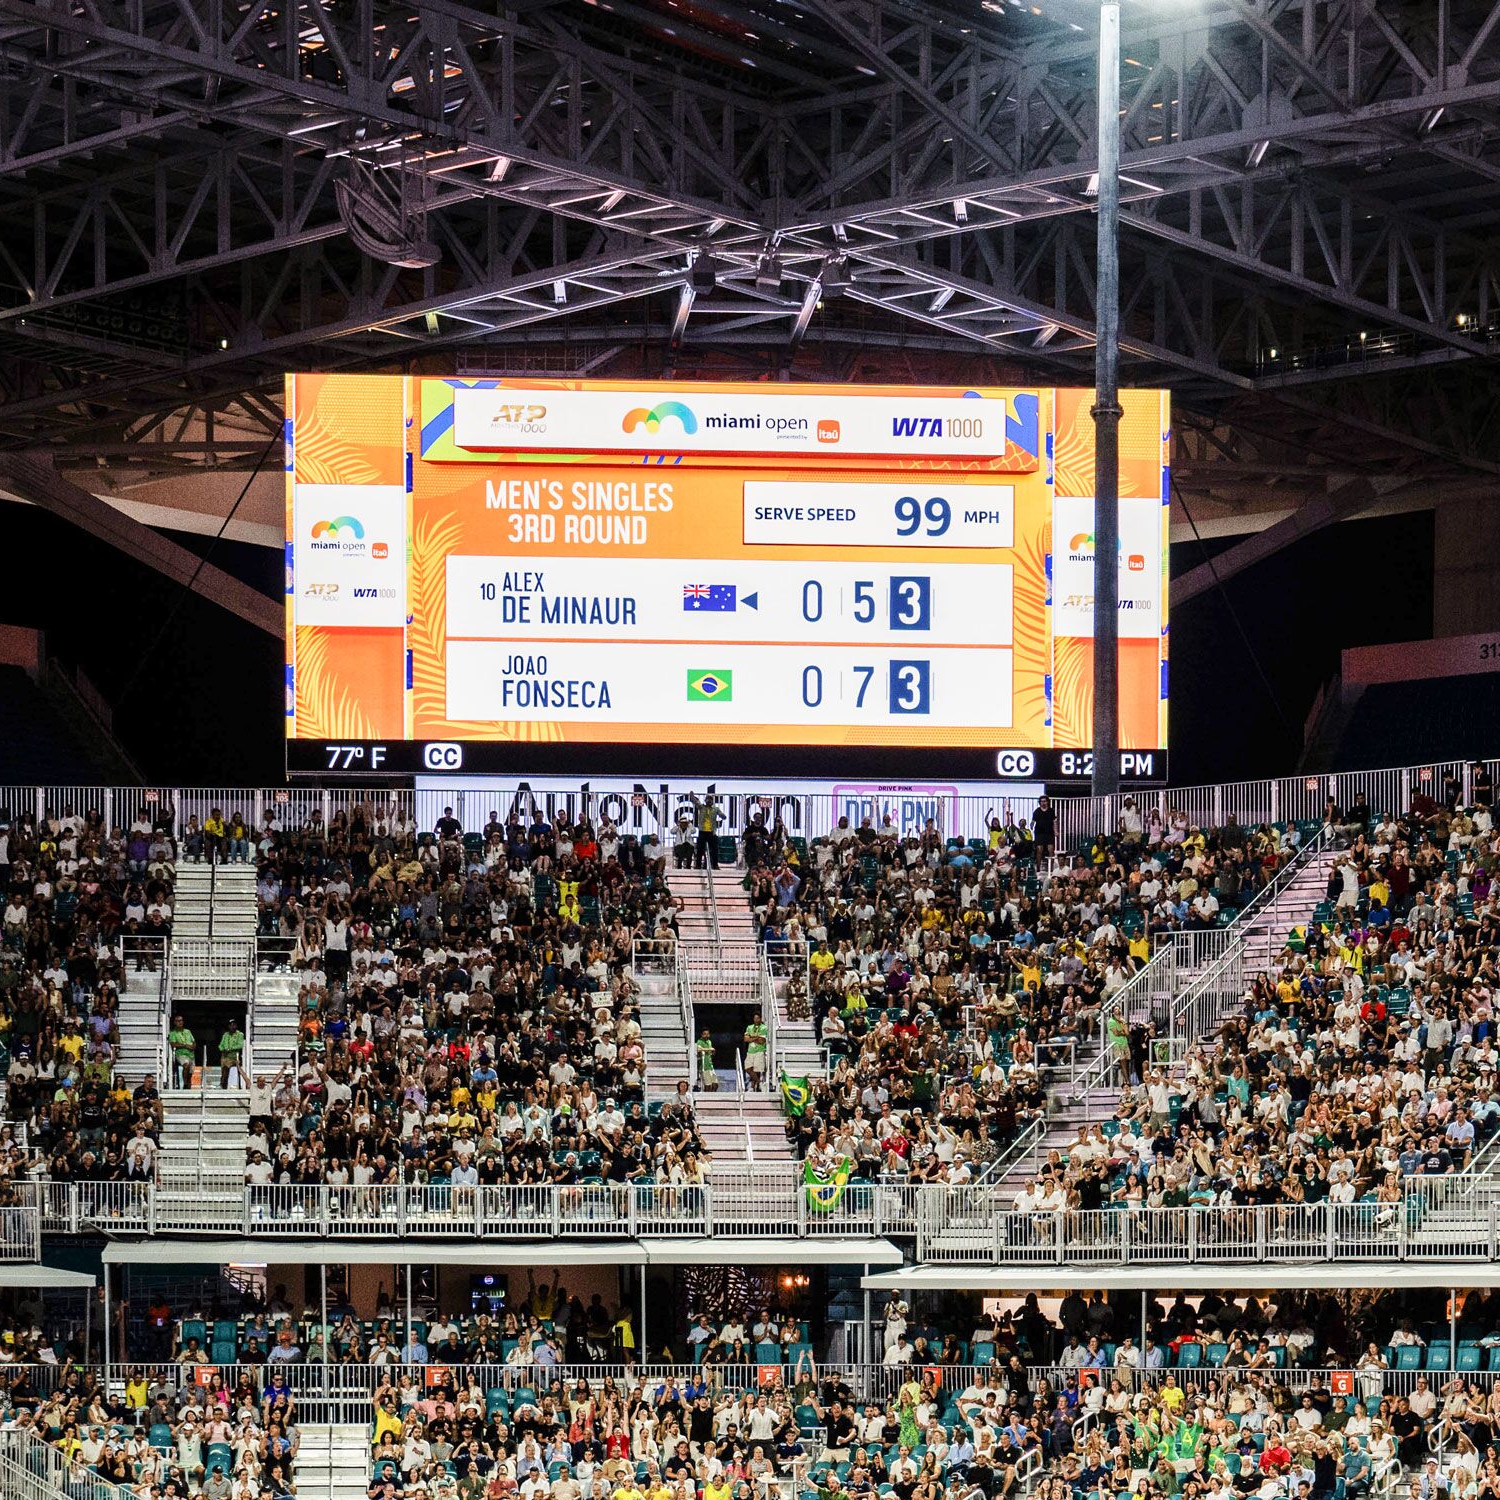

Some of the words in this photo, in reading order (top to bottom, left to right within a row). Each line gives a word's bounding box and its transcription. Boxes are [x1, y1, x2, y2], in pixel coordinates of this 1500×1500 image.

[491, 404, 547, 423] ATP
[706, 413, 761, 429] miami
[765, 415, 808, 434] open
[892, 417, 943, 437] WTA
[947, 418, 983, 438] 1000
[485, 479, 564, 510] MEN'S
[571, 481, 674, 512] SINGLES
[755, 506, 804, 520] SERVE
[807, 507, 856, 521] SPEED
[894, 496, 951, 536] 99
[964, 510, 1000, 525] MPH
[508, 514, 556, 544] 3RD
[564, 514, 647, 545] ROUND
[310, 540, 341, 550] miami
[342, 542, 366, 554] open
[480, 582, 496, 601] 10
[502, 572, 545, 592] ALEX
[353, 588, 378, 598] WTA
[378, 588, 396, 599] 1000
[802, 579, 823, 622] 0
[853, 580, 876, 624] 5
[897, 581, 922, 625] 3
[502, 595, 531, 624] DE
[540, 596, 637, 626] MINAUR
[502, 655, 548, 676] JOAO
[502, 679, 611, 709] FONSECA
[802, 664, 823, 708] 0
[852, 666, 875, 708] 7
[897, 665, 921, 710] 3
[371, 747, 387, 769] F
[428, 747, 458, 766] CC
[1000, 754, 1031, 773] CC
[1121, 754, 1153, 776] PM
[1305, 781, 1319, 790] 106
[1420, 772, 1433, 780] 107
[145, 792, 159, 801] 104
[276, 794, 290, 803] 105
[504, 781, 802, 830] AutoNation
[631, 799, 645, 807] 105
[202, 1373, 212, 1384] D
[433, 1373, 441, 1383] E
[1338, 1379, 1347, 1391] G
